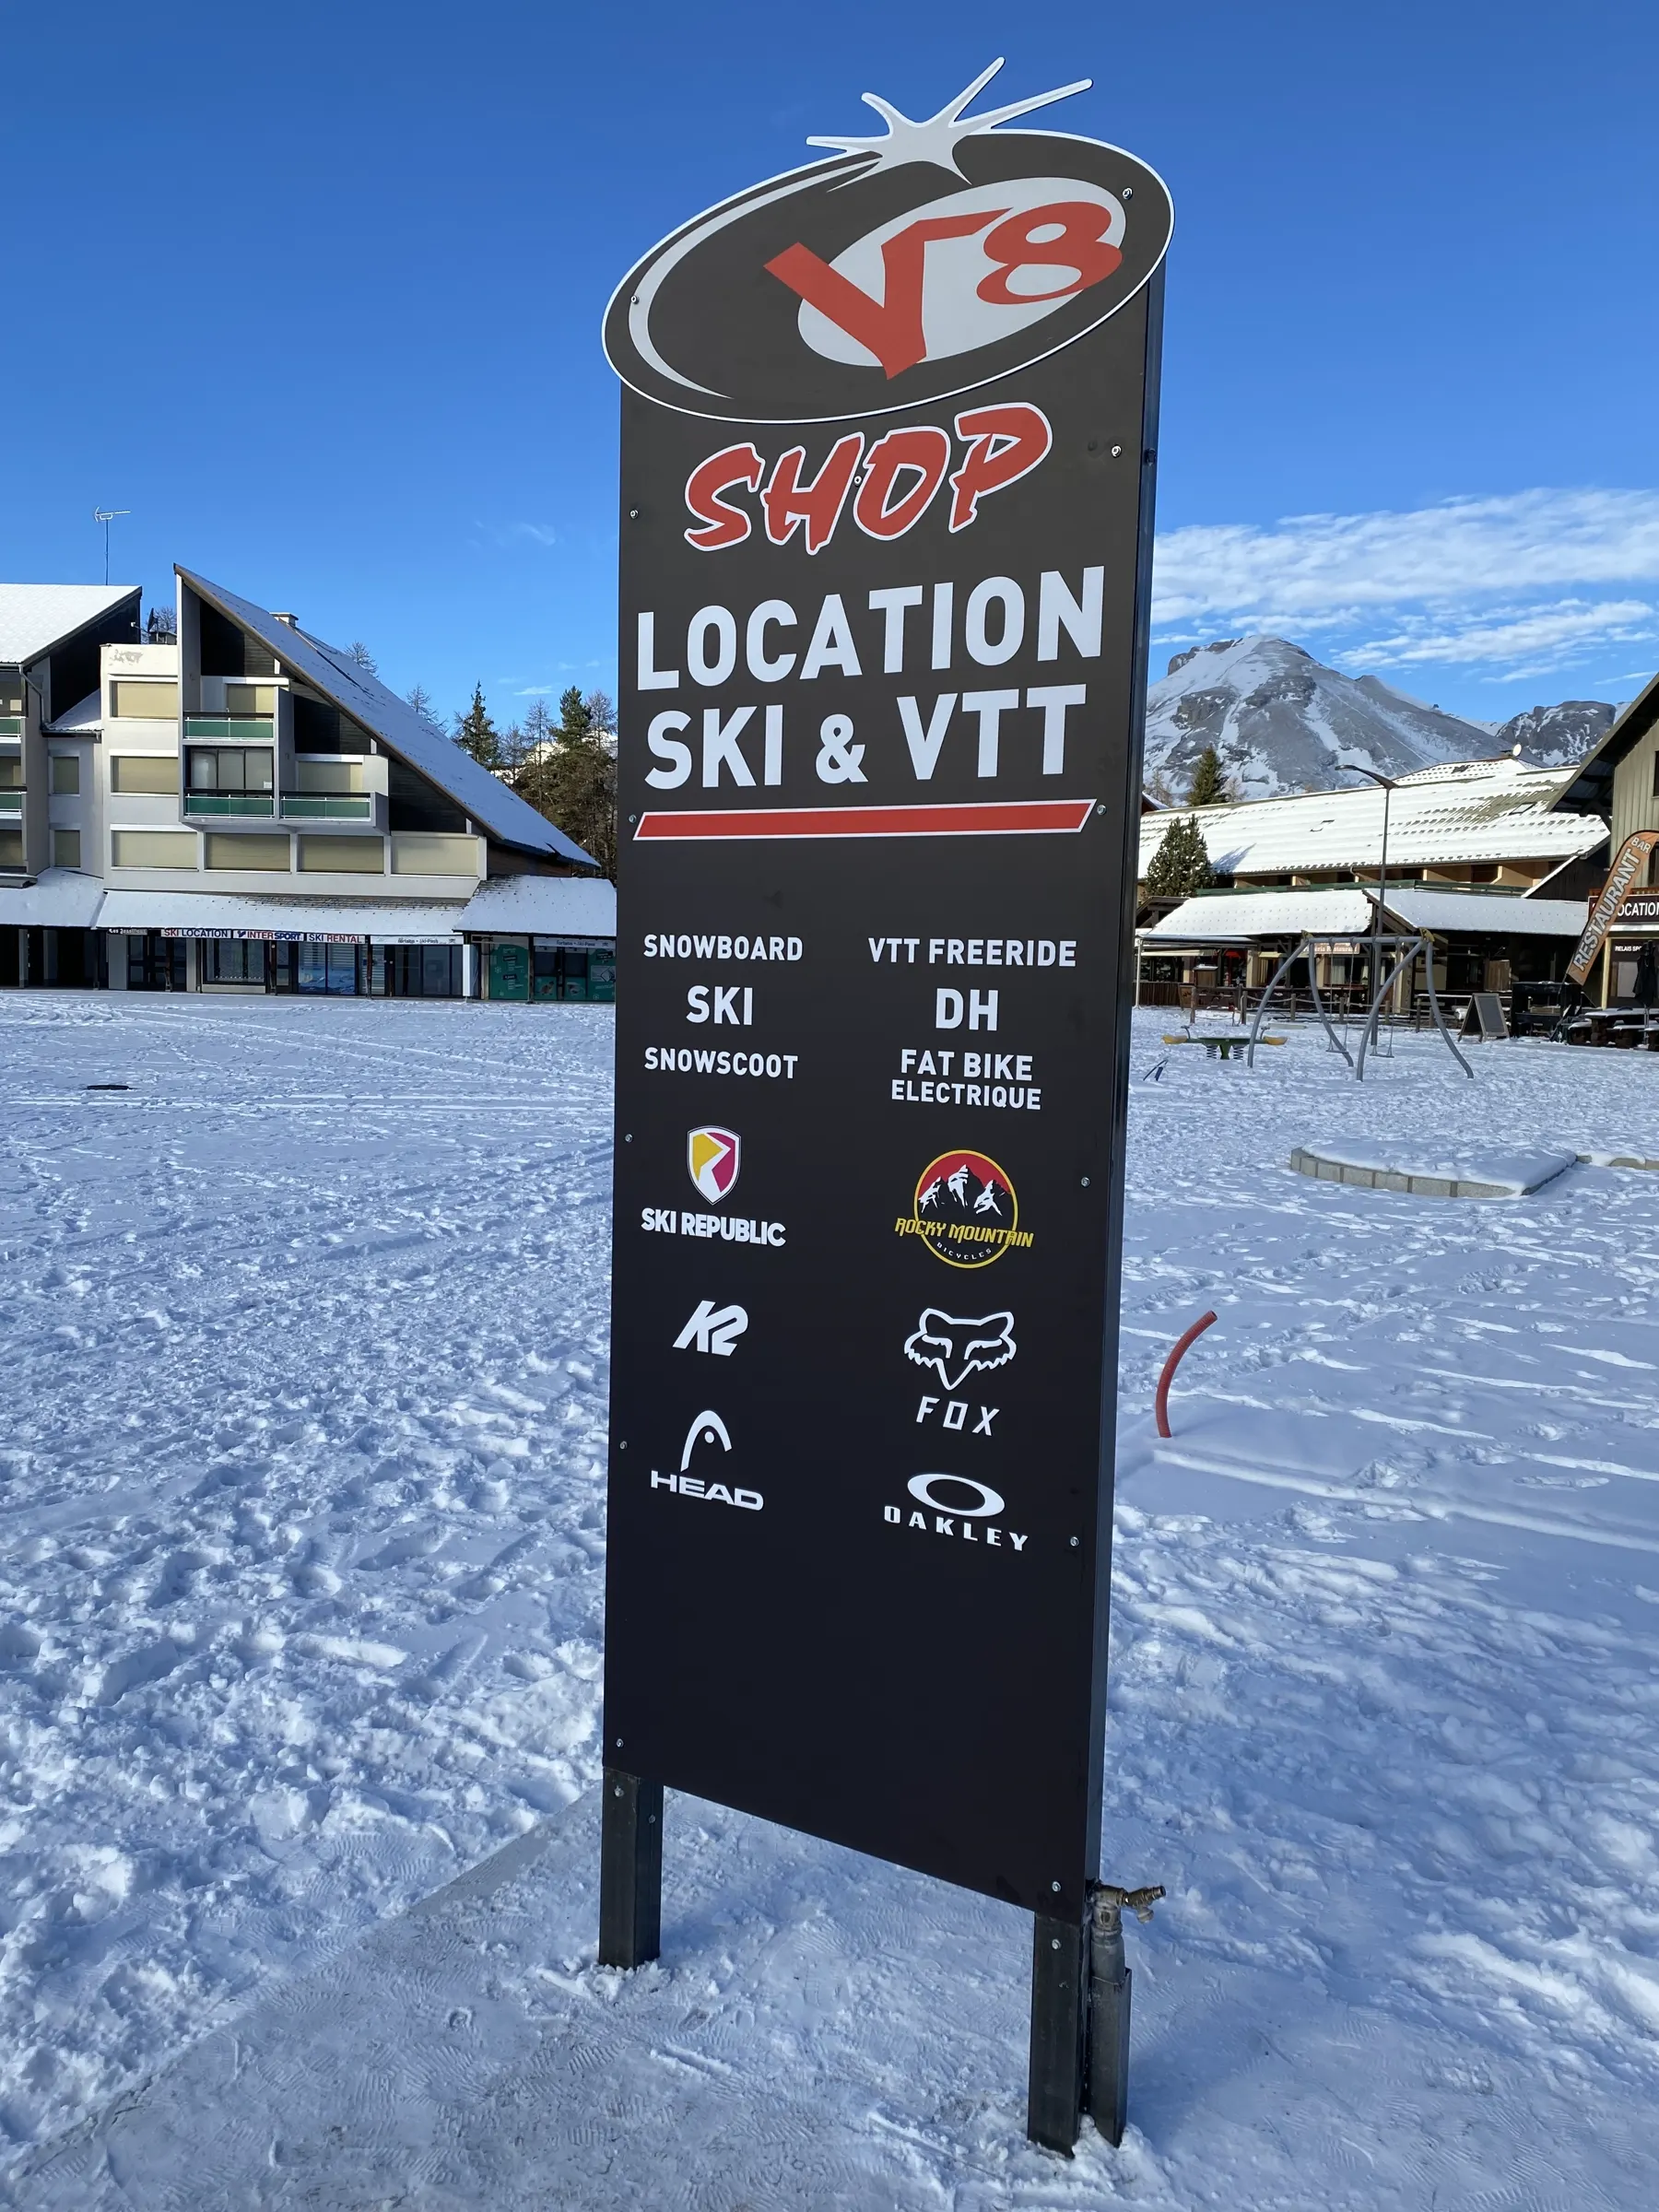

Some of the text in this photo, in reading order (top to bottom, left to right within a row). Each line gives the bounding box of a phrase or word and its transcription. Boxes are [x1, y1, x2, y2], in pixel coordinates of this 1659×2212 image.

[763, 201, 1123, 380] V8
[684, 403, 1053, 555] SHOP
[638, 566, 1104, 690] LOCATION
[645, 684, 1086, 789] SKI & VTT
[1630, 836, 1652, 854] BAR
[1572, 848, 1641, 972] RESTAURANT
[1618, 902, 1659, 917] OCATIO
[164, 928, 229, 937] SKI LOCATION
[247, 930, 302, 940] INTERSPORT
[309, 933, 363, 944] SKI RENTAL
[643, 935, 802, 960] SNOWBOARD
[868, 938, 1077, 966] VTT FREERIDE
[687, 985, 752, 1025] SKI
[935, 988, 998, 1030] DH
[644, 1047, 797, 1078] SNOWSCOOT
[901, 1049, 1032, 1080] FAT BIKE
[892, 1078, 1041, 1110] ELECTRIQUE
[641, 1208, 786, 1246] SKI REPUBLIC
[895, 1218, 1034, 1248] ROCKY MOUNTAIN
[936, 1241, 992, 1261] BICYCLES
[673, 1300, 748, 1356] K2
[916, 1396, 999, 1436] FOX
[651, 1470, 763, 1510] HEAD
[884, 1505, 1029, 1551] OAKLEY
